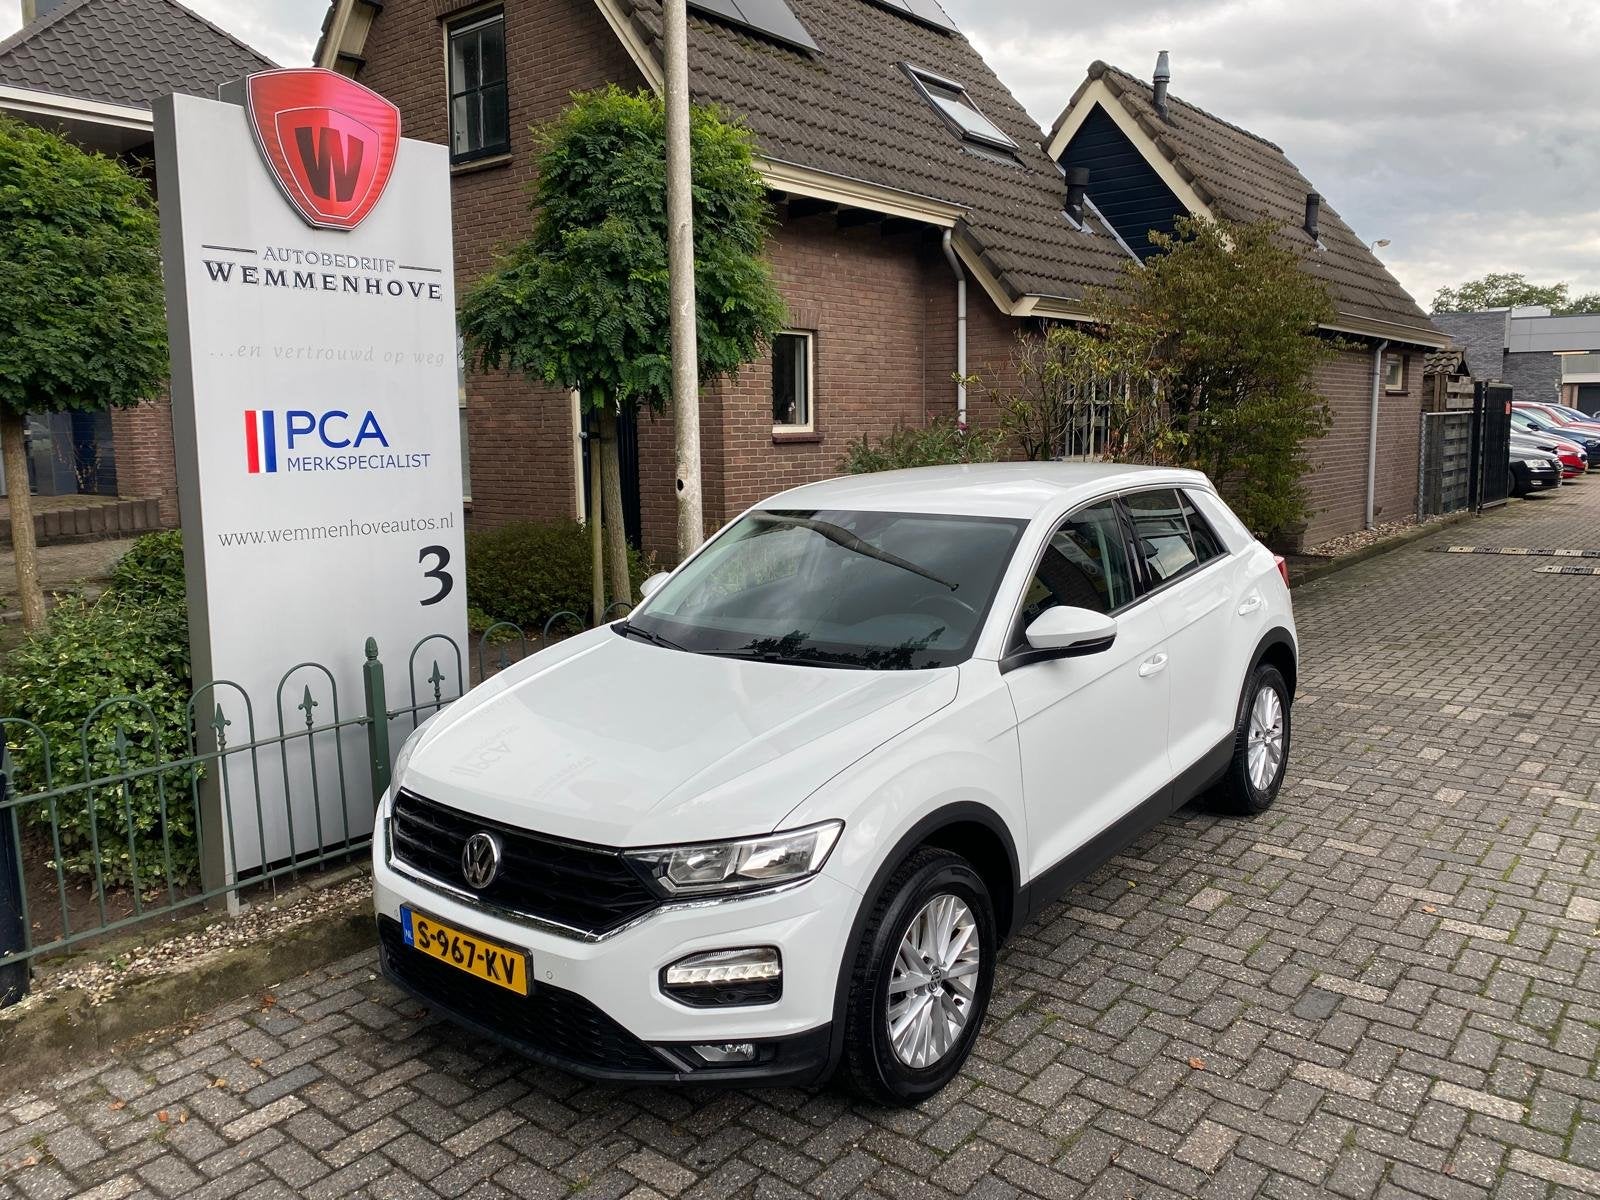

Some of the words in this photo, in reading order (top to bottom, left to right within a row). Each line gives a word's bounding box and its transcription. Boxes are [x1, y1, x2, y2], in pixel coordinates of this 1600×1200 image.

[295, 126, 364, 202] W
[263, 246, 396, 272] AUTOBEDRIJF
[203, 260, 443, 300] WEMMENHOVE
[273, 346, 374, 362] vertrouwd
[384, 350, 404, 366] op
[414, 352, 445, 366] weg
[286, 410, 389, 449] PCA
[287, 453, 431, 472] MERKSPECIALIST
[218, 512, 454, 546] www.wemmenhoveautos.nl
[418, 544, 453, 606] 3
[418, 921, 515, 984] S-967-KV
